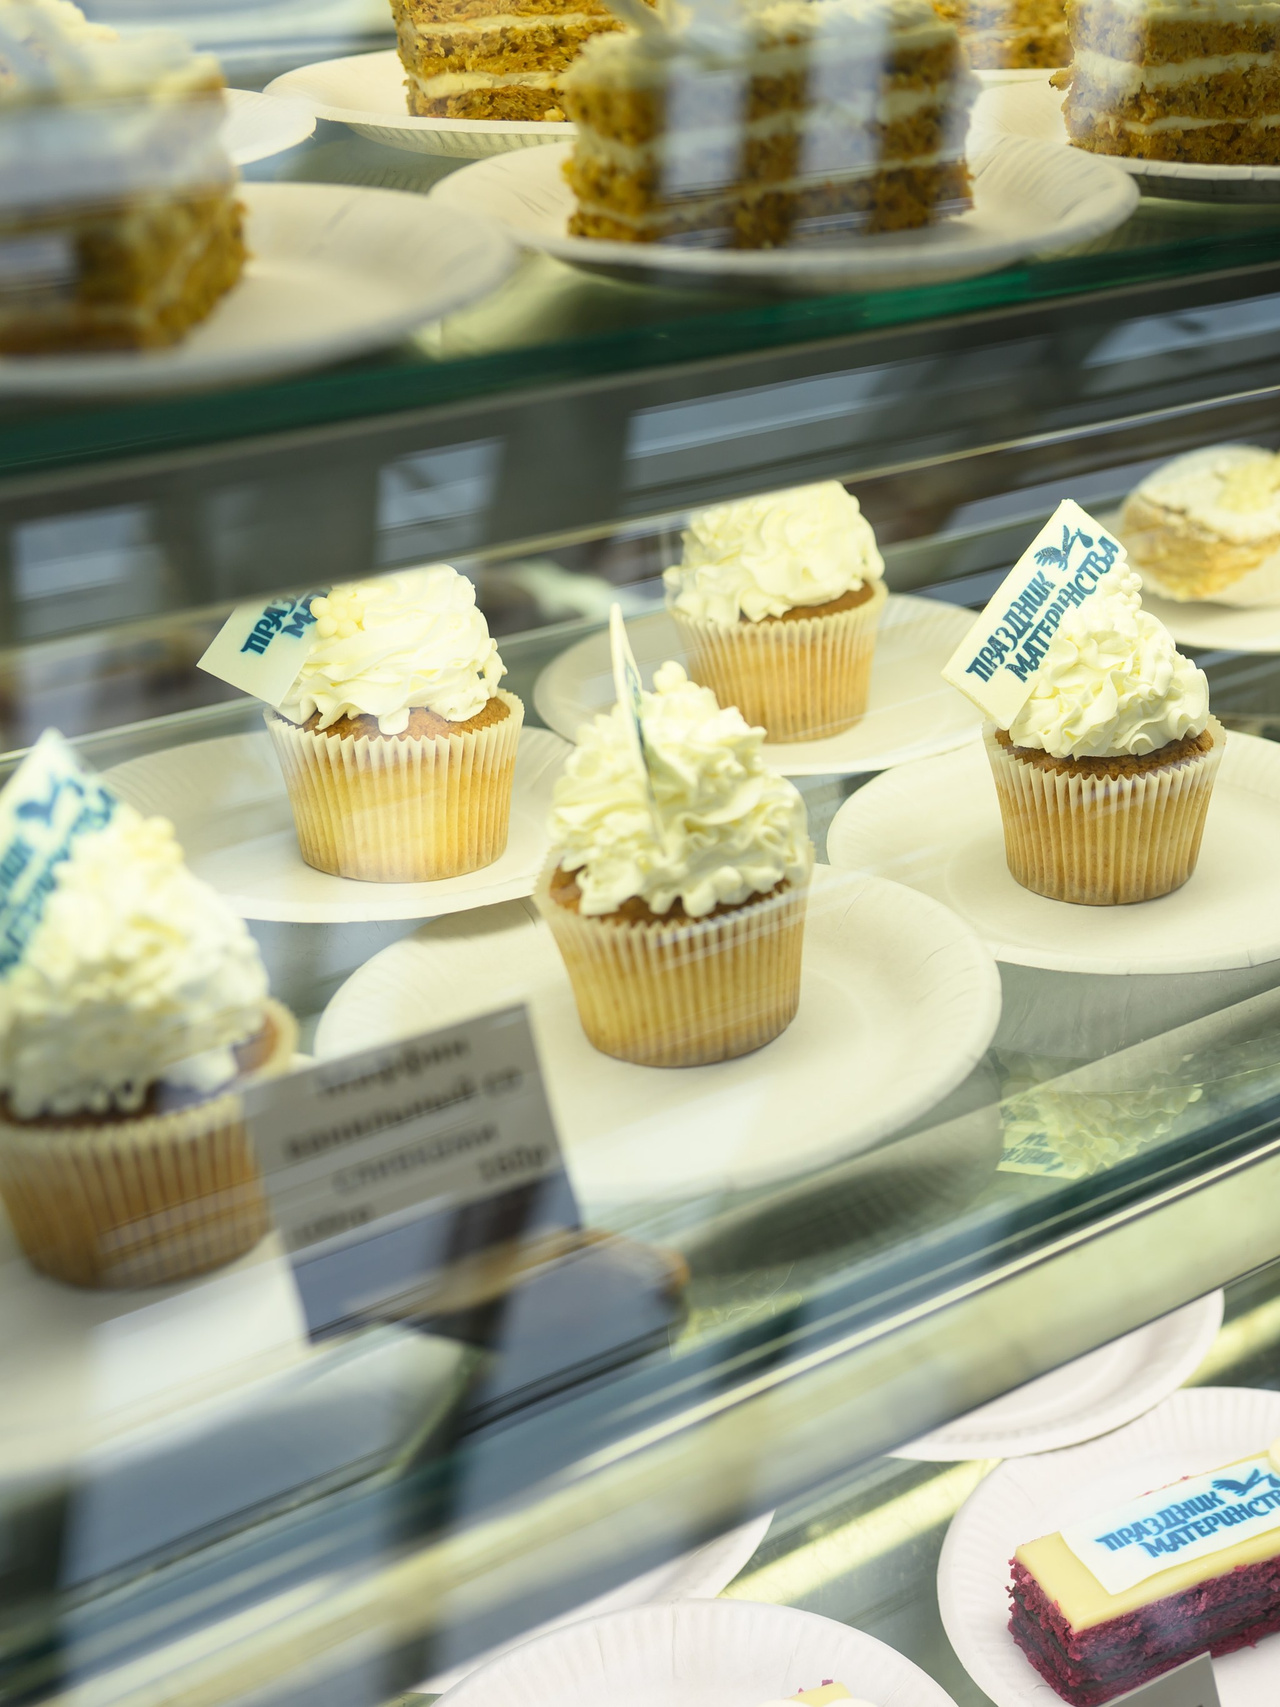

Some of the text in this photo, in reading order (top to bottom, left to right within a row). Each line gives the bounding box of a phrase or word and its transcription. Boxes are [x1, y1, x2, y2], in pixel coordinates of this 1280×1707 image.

[240, 594, 299, 656] ПРАЗ
[965, 570, 1056, 683] ПРАЗДНИК
[1005, 536, 1119, 684] МАТЕРИНСТВА
[1095, 1490, 1227, 1552] ПРАЗДНИК
